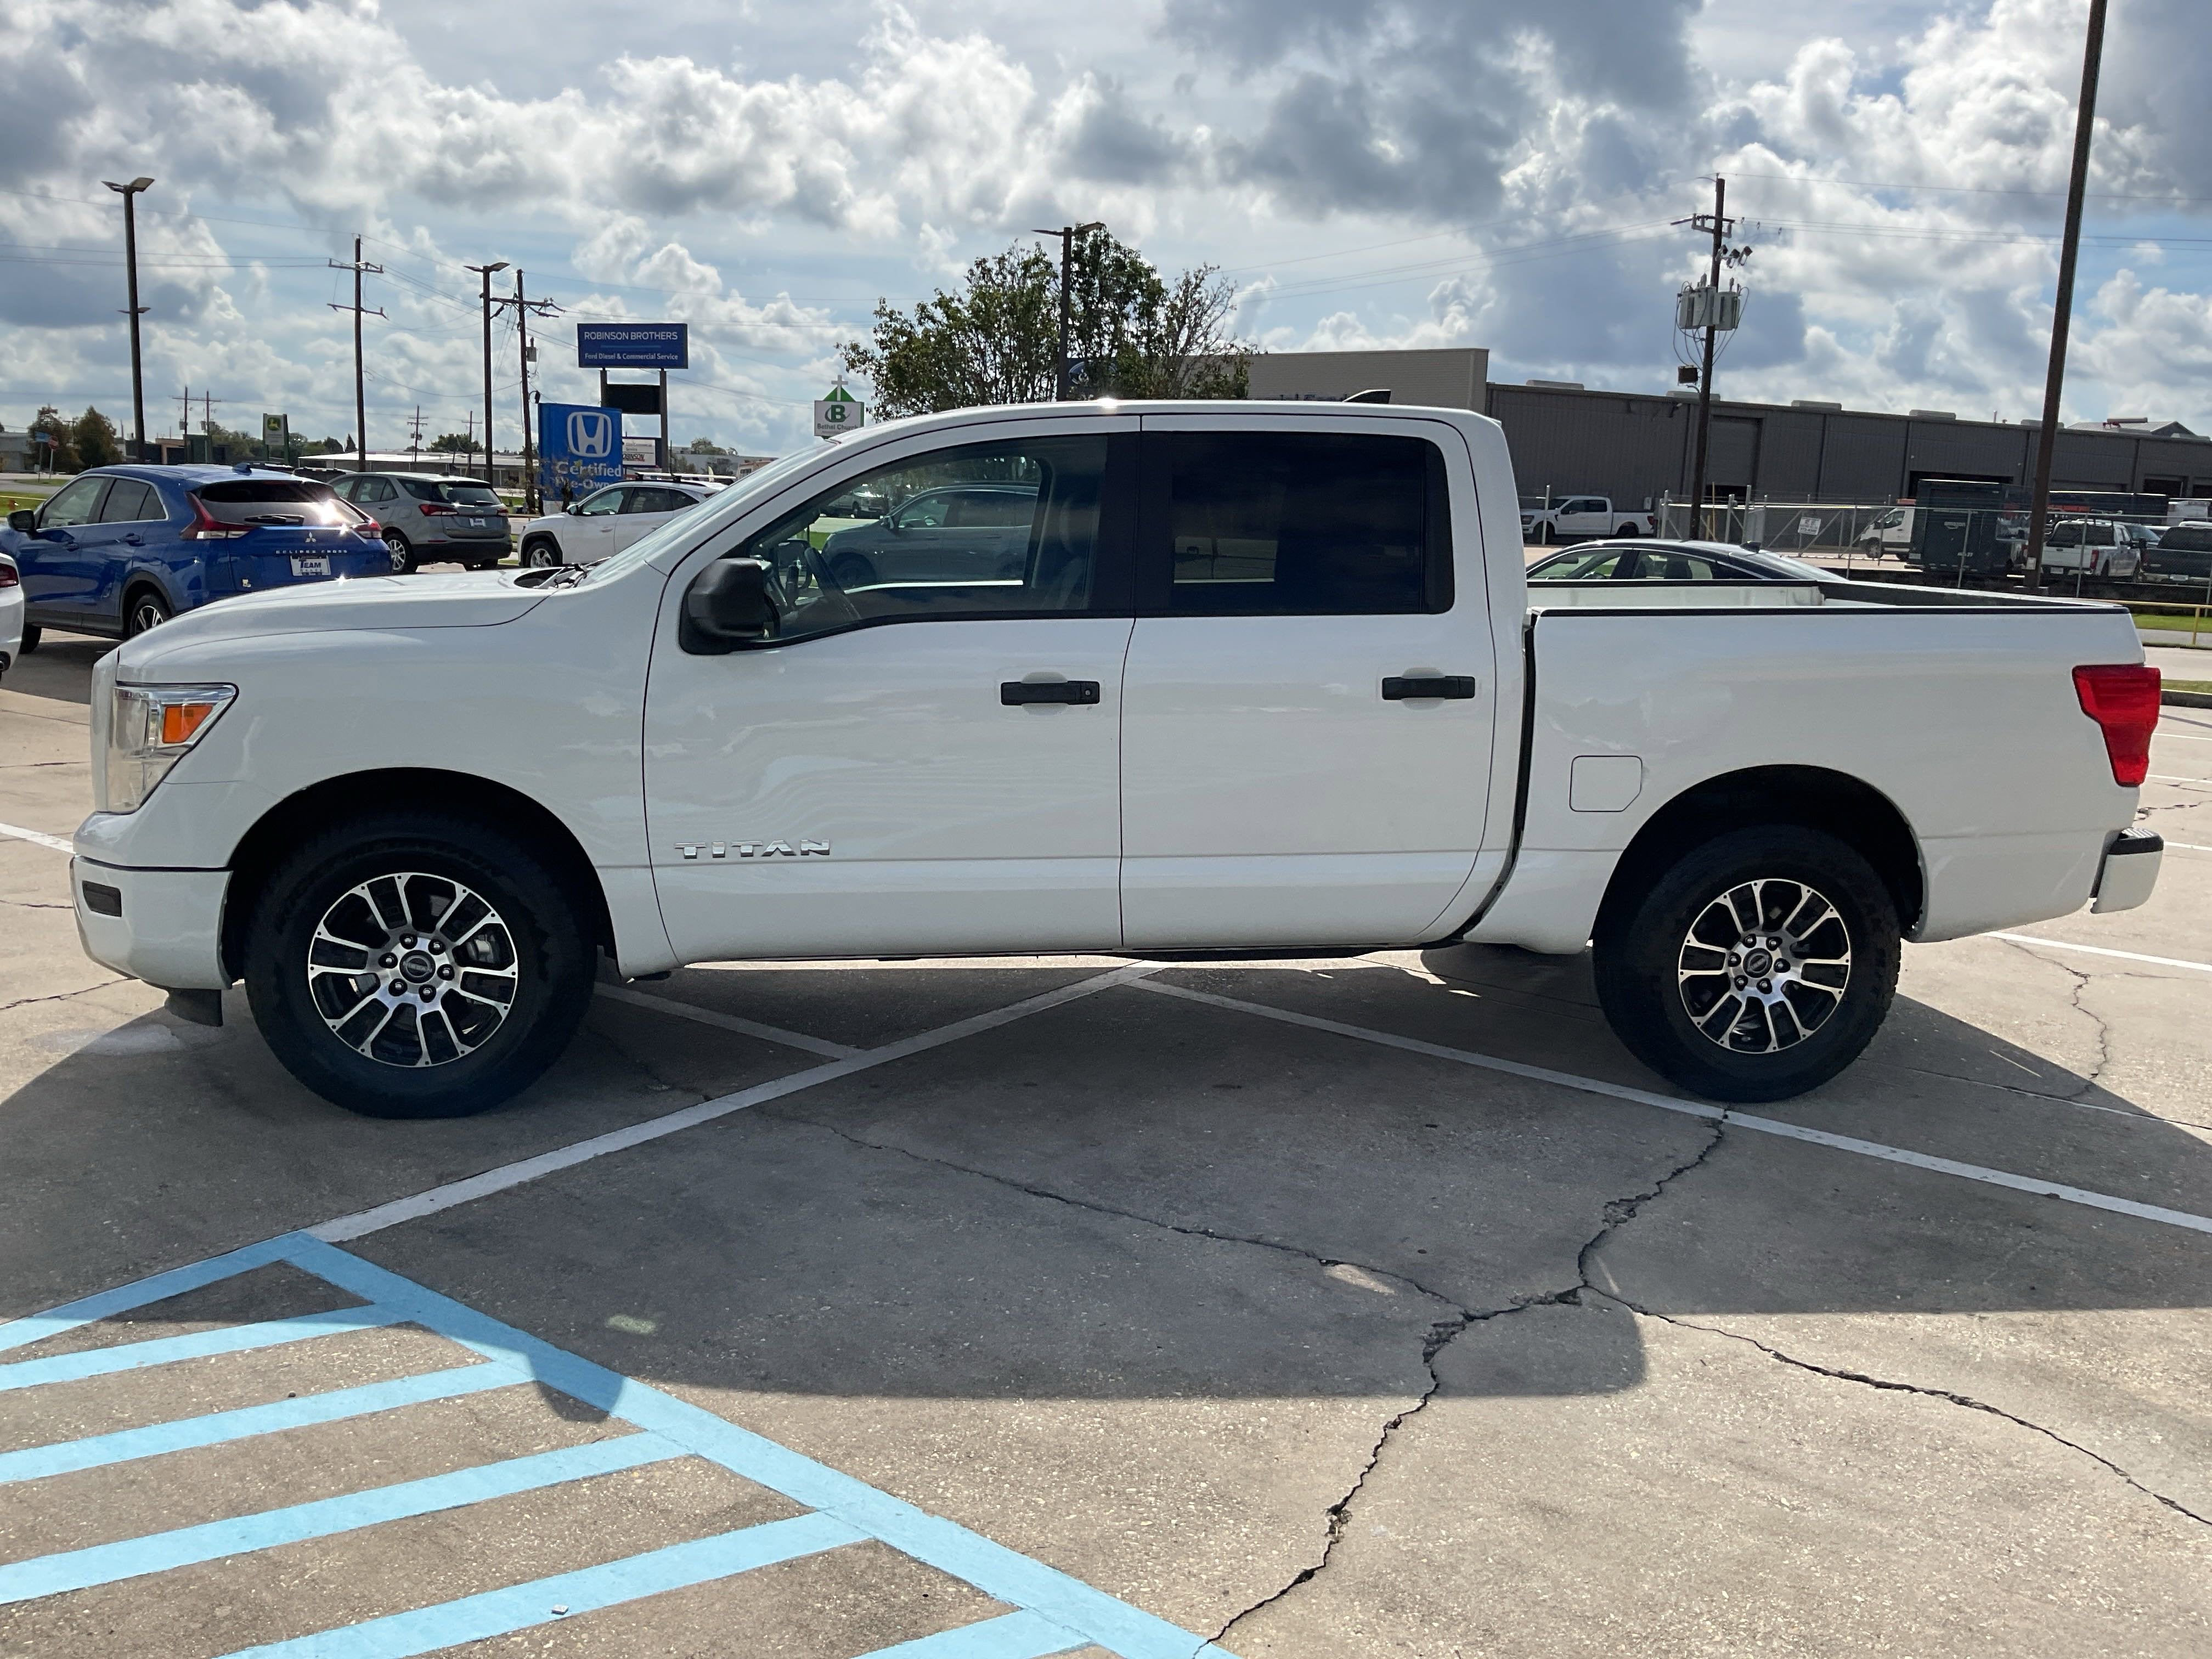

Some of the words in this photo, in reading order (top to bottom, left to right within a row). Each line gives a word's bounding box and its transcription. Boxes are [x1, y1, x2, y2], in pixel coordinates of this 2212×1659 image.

[584, 331, 629, 340] ROBINSON
[630, 331, 678, 340] BROTHERS
[831, 404, 846, 422] B
[556, 461, 622, 477] Certified
[298, 559, 321, 568] TEAM
[674, 839, 830, 859] TITAN
